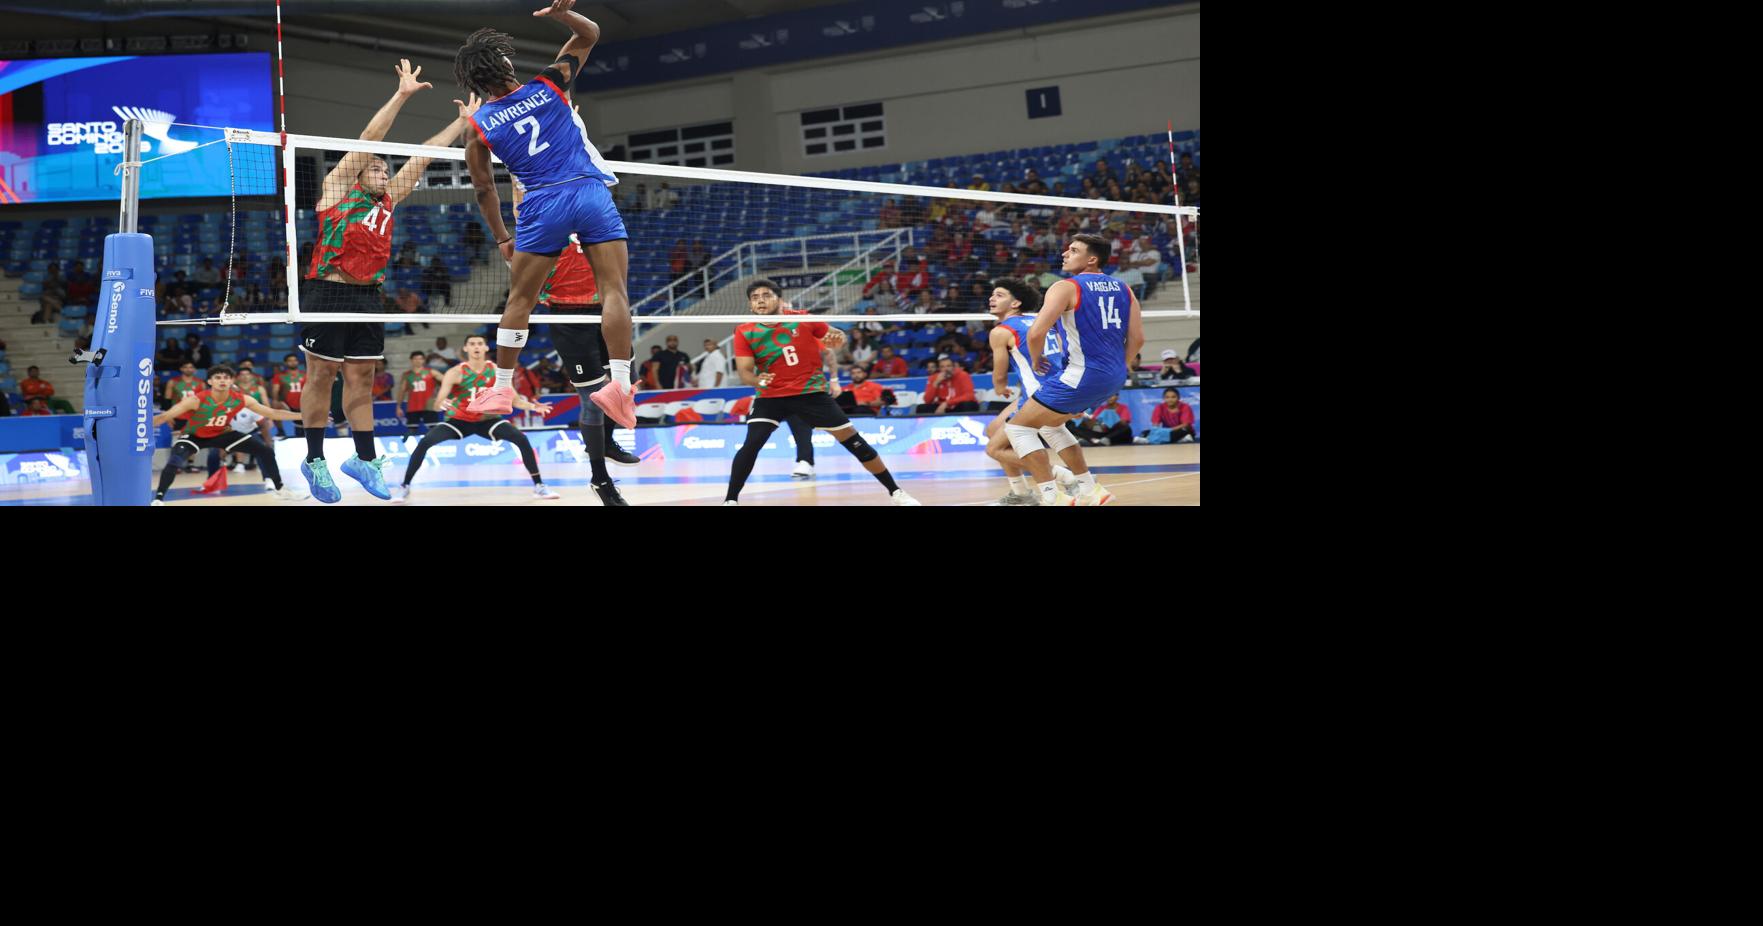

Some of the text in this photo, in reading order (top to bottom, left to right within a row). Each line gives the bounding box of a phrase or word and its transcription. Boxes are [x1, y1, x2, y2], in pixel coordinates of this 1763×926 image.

[481, 89, 552, 131] LAWRENCE
[47, 121, 117, 134] SANTO
[47, 131, 125, 146] DOMING
[513, 115, 550, 157] 2
[94, 140, 152, 154] 20
[361, 205, 392, 236] 47
[107, 293, 122, 335] Senoh
[1098, 296, 1122, 330] 14
[782, 345, 799, 366] 6
[575, 364, 584, 375] 9
[136, 379, 151, 452] Senoh
[205, 415, 228, 427] 18
